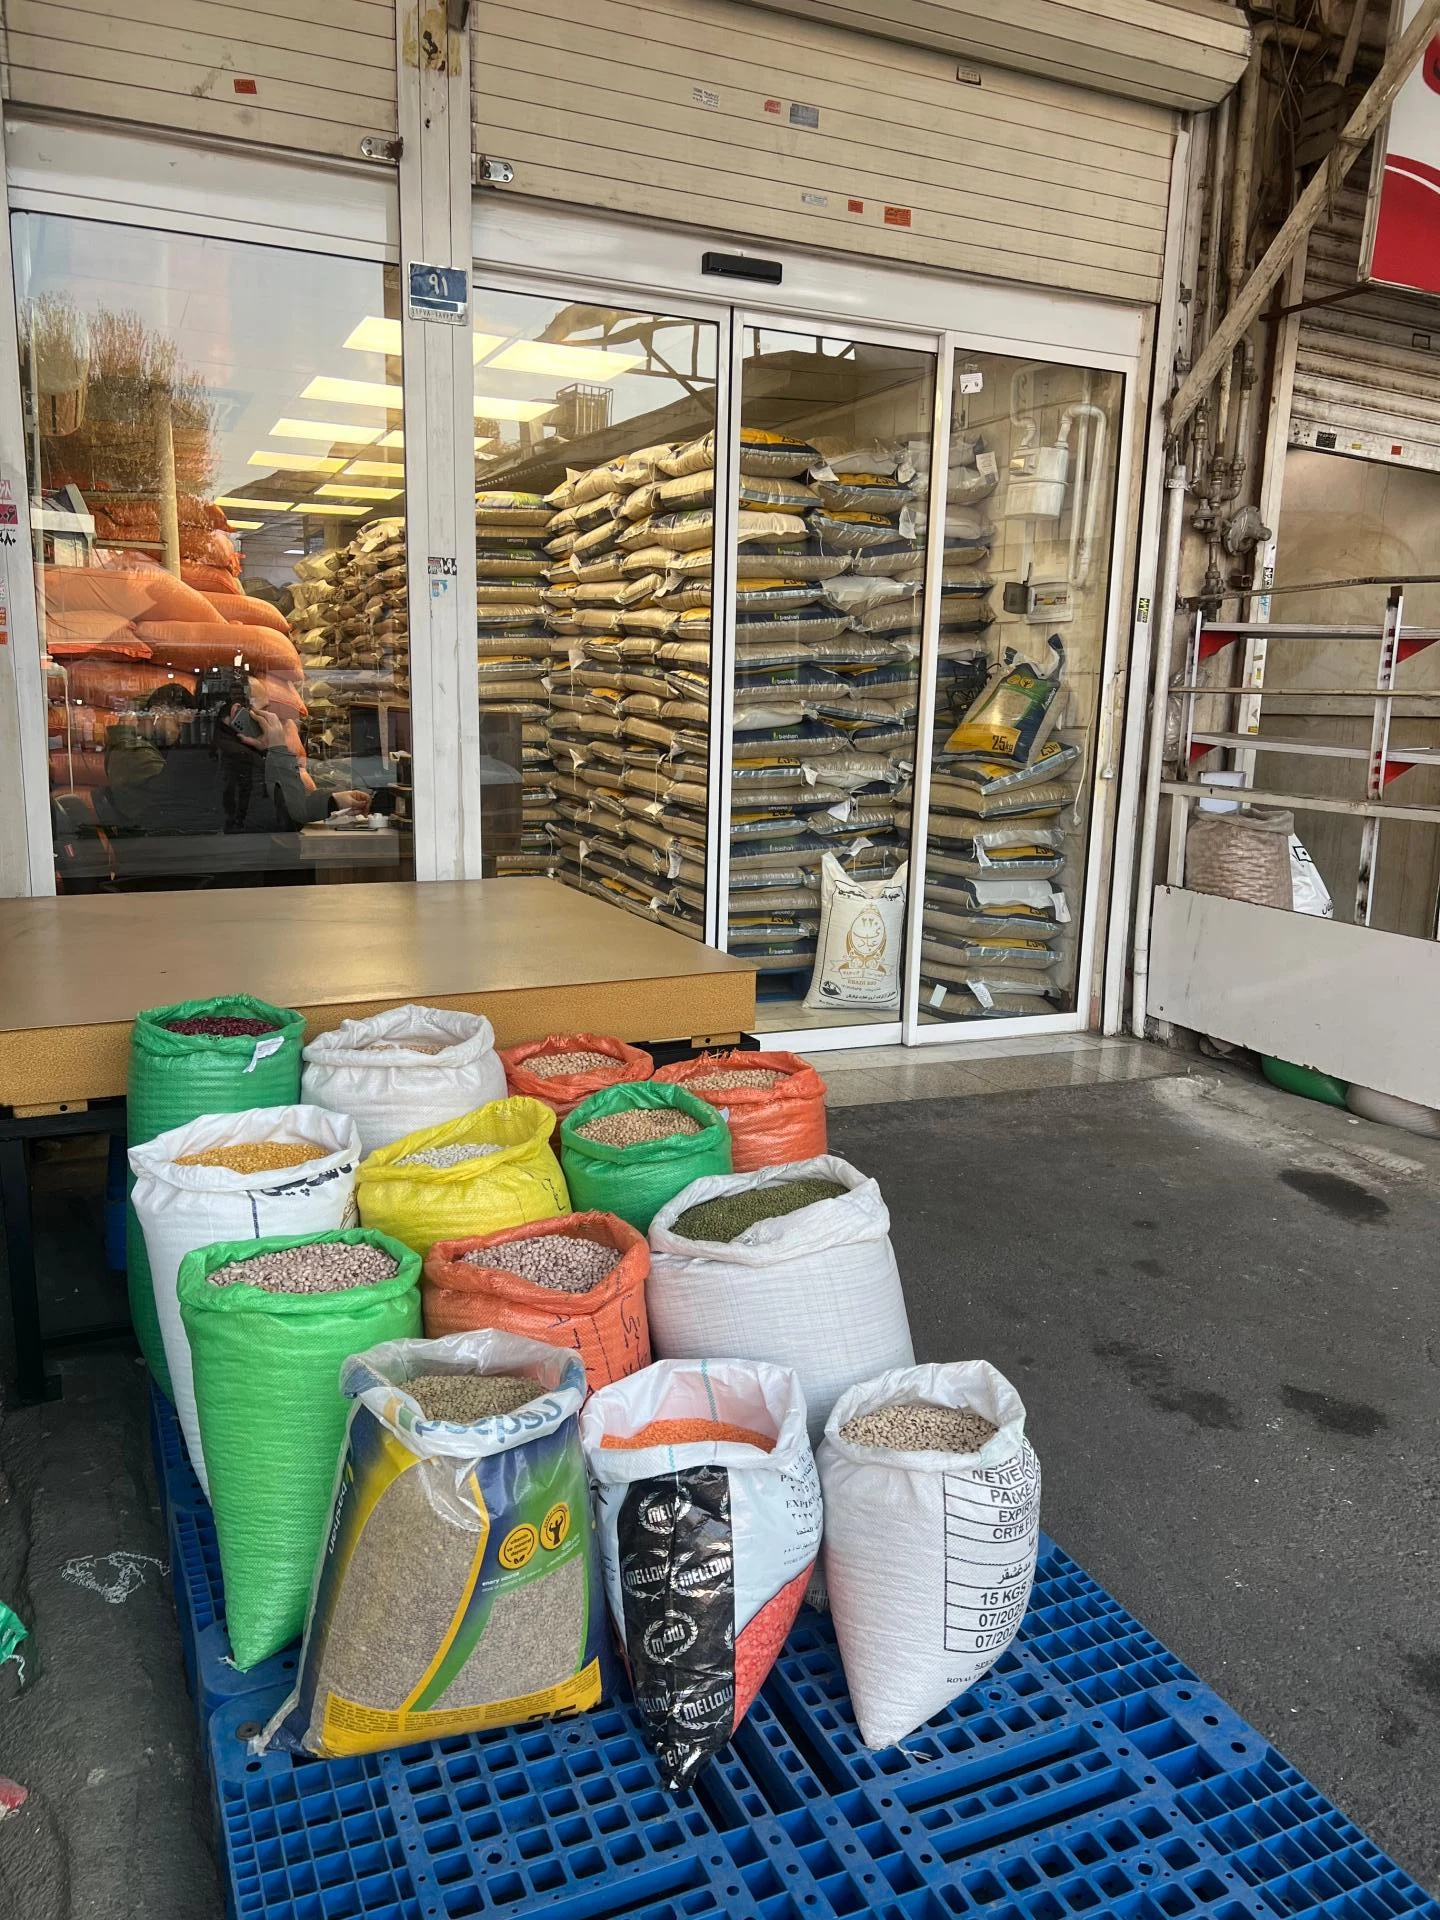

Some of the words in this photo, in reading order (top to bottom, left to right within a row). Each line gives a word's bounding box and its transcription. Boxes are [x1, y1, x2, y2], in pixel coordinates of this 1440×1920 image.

[991, 734, 1013, 753] 25kg
[328, 1481, 348, 1555] bashan
[679, 1556, 732, 1587] MELLOW
[980, 1592, 999, 1606] 15
[1002, 1581, 1027, 1604] KGS
[683, 1685, 734, 1720] MELLOW
